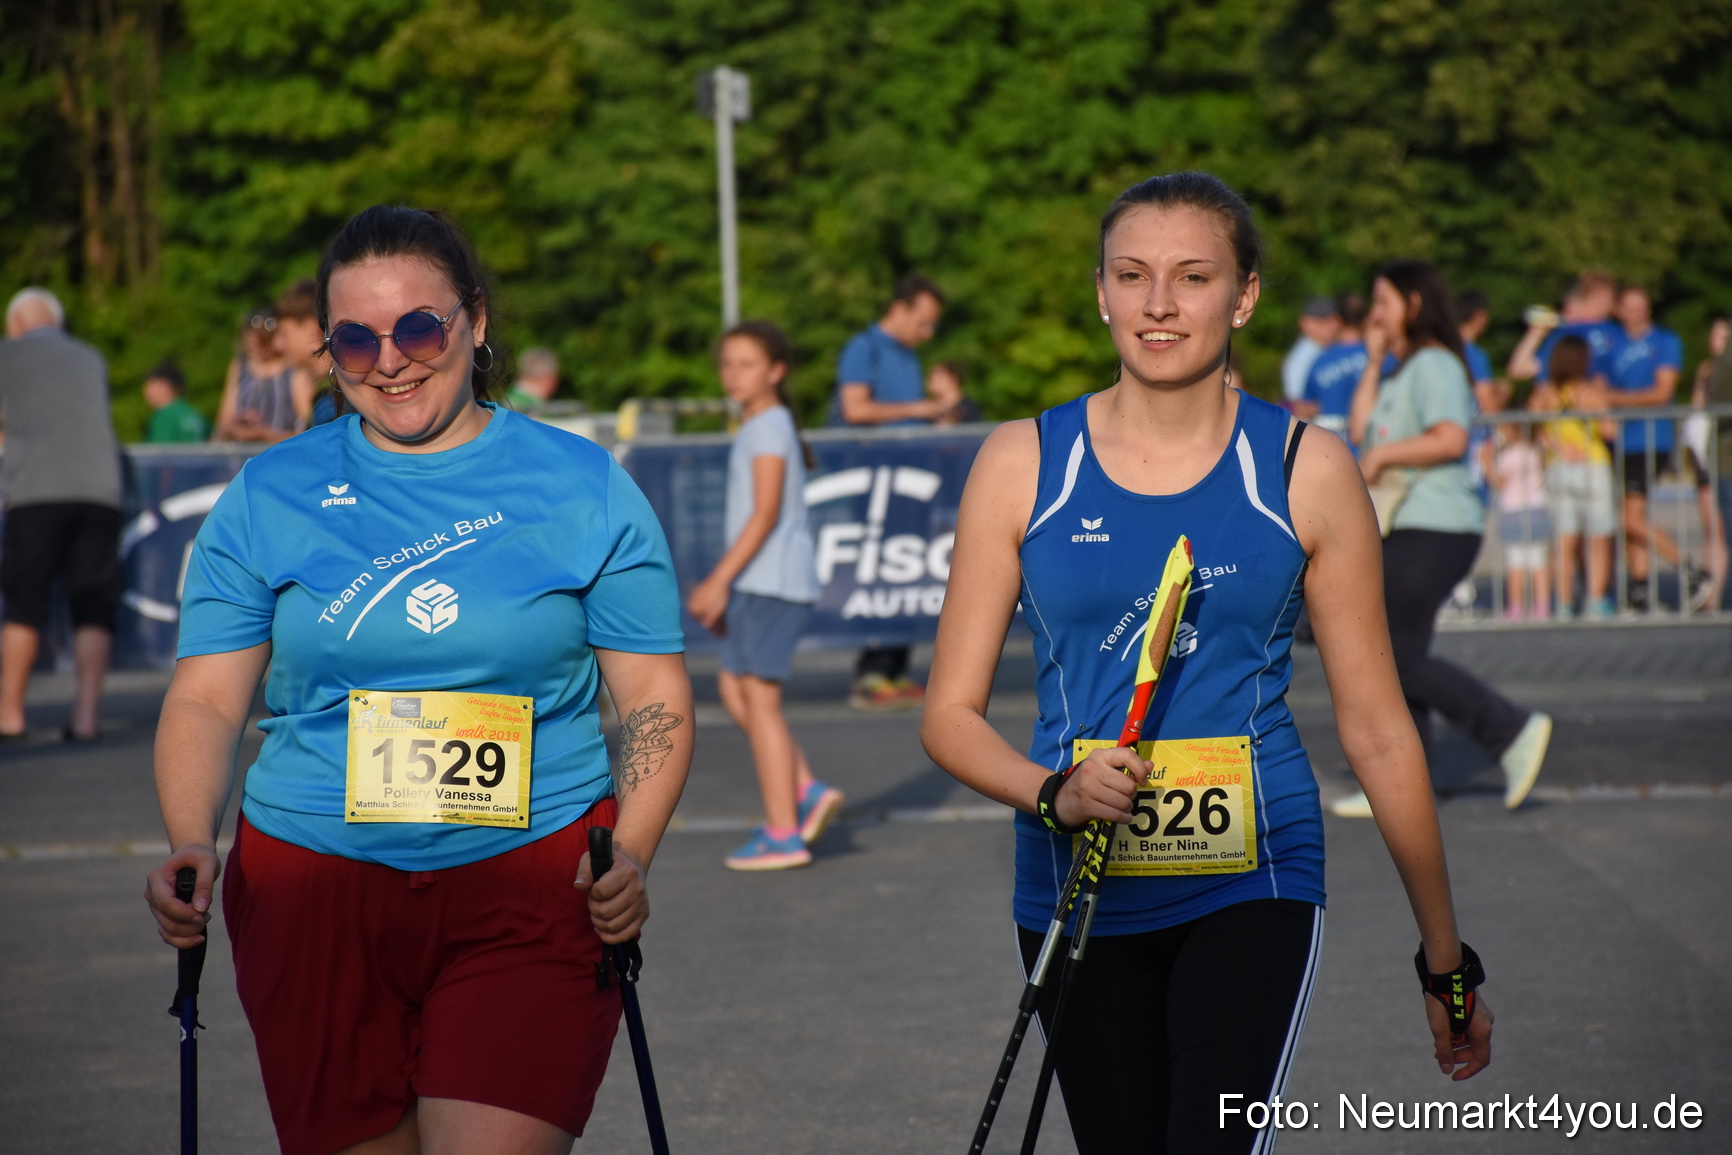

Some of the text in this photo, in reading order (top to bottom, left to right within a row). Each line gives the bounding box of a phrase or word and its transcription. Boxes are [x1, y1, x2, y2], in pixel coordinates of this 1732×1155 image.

[321, 496, 357, 508] erima
[1071, 532, 1110, 543] erima
[815, 524, 954, 586] Fisc
[317, 511, 504, 624] Team Schick Bau
[1198, 563, 1237, 580] Bau
[841, 587, 947, 620] AUTO
[1099, 610, 1136, 652] Team
[466, 696, 521, 714] Gesunde Firmen
[377, 715, 449, 729] firmenlauf
[455, 724, 521, 742] walk 2019
[1184, 743, 1240, 755] Gesunde Firmen
[372, 737, 506, 788] 1529
[1198, 753, 1221, 763] laufen
[1175, 771, 1207, 787] walk
[1209, 773, 1241, 786] 2019
[435, 787, 492, 802] Vanessa
[355, 800, 390, 808] Matthias
[492, 804, 518, 813] GmbH
[1128, 787, 1231, 838] 526
[1177, 839, 1208, 851] Nina
[1117, 853, 1145, 862] Schick
[1147, 853, 1218, 862] Bauunternehmen
[1220, 851, 1246, 859] GmbH
[1452, 974, 1465, 1019] LEKI
